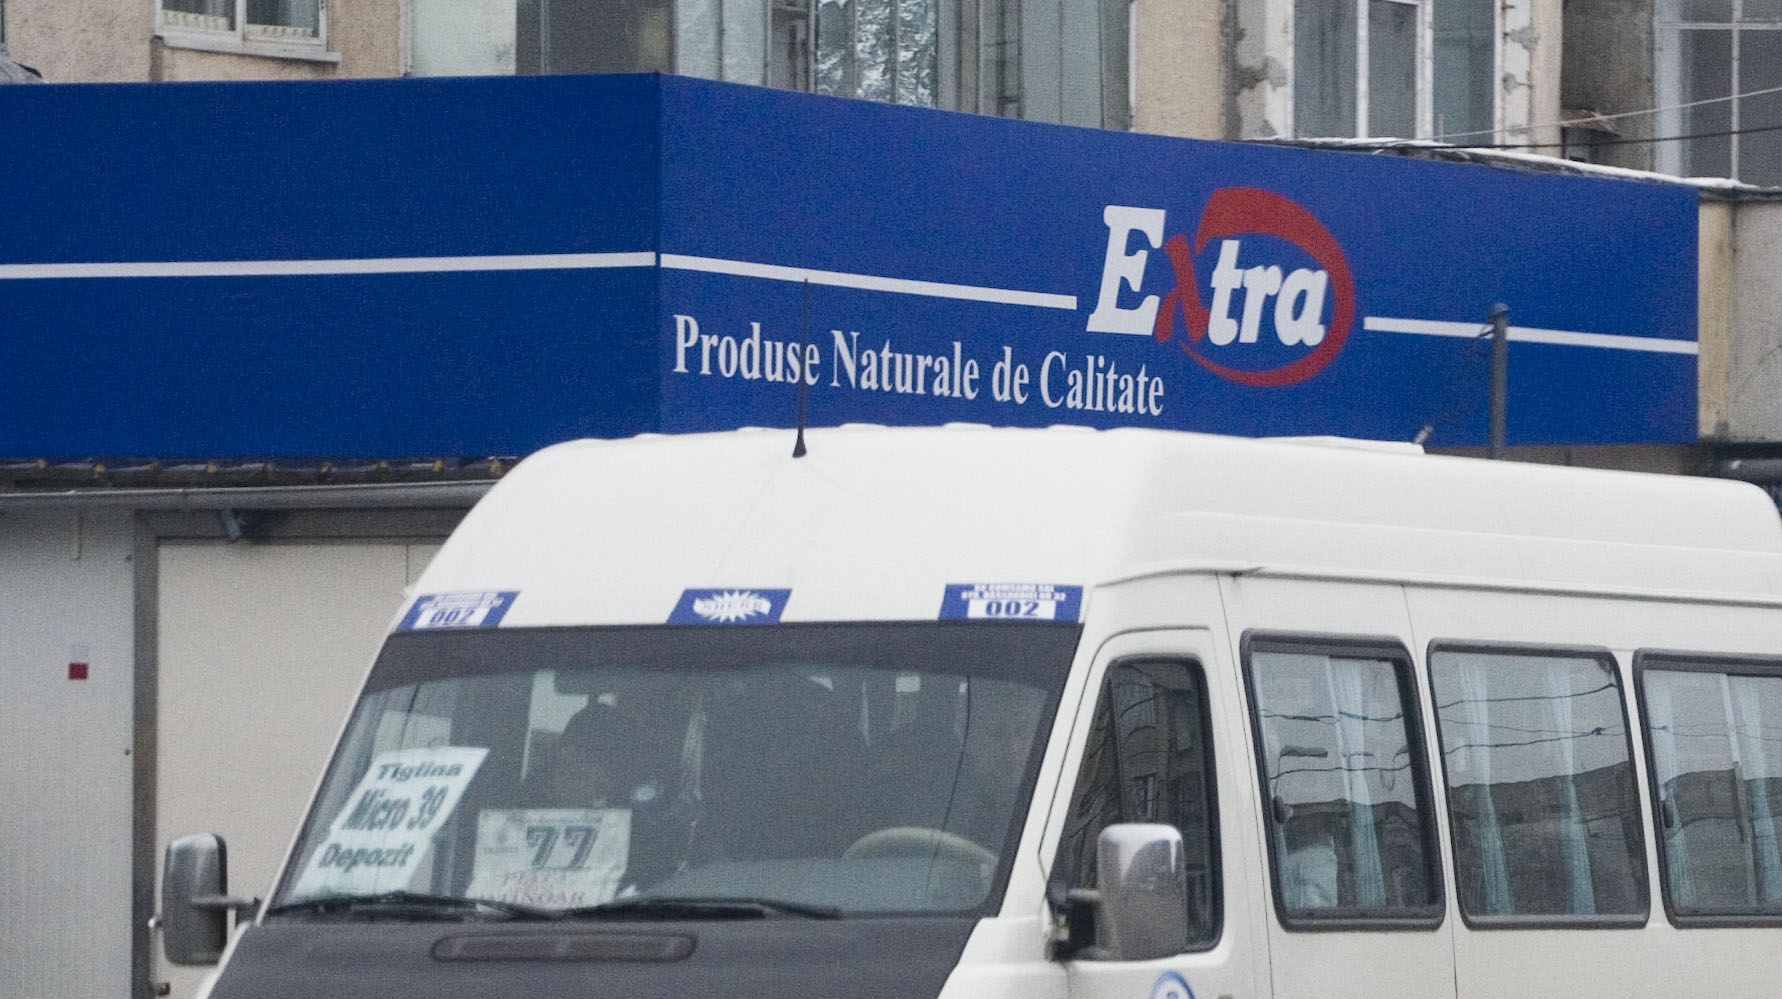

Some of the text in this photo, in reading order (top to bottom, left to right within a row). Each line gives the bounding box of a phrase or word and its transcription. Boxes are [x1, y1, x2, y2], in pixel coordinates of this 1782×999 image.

[1087, 204, 1327, 347] Extra
[673, 314, 1165, 417] Produse Naturale de Calitate
[429, 609, 475, 625] 002
[984, 600, 1040, 617] 002
[376, 761, 464, 782] Tiglina
[341, 785, 450, 832] Micro 39
[318, 841, 416, 874] Depozit
[525, 825, 599, 872] 77
